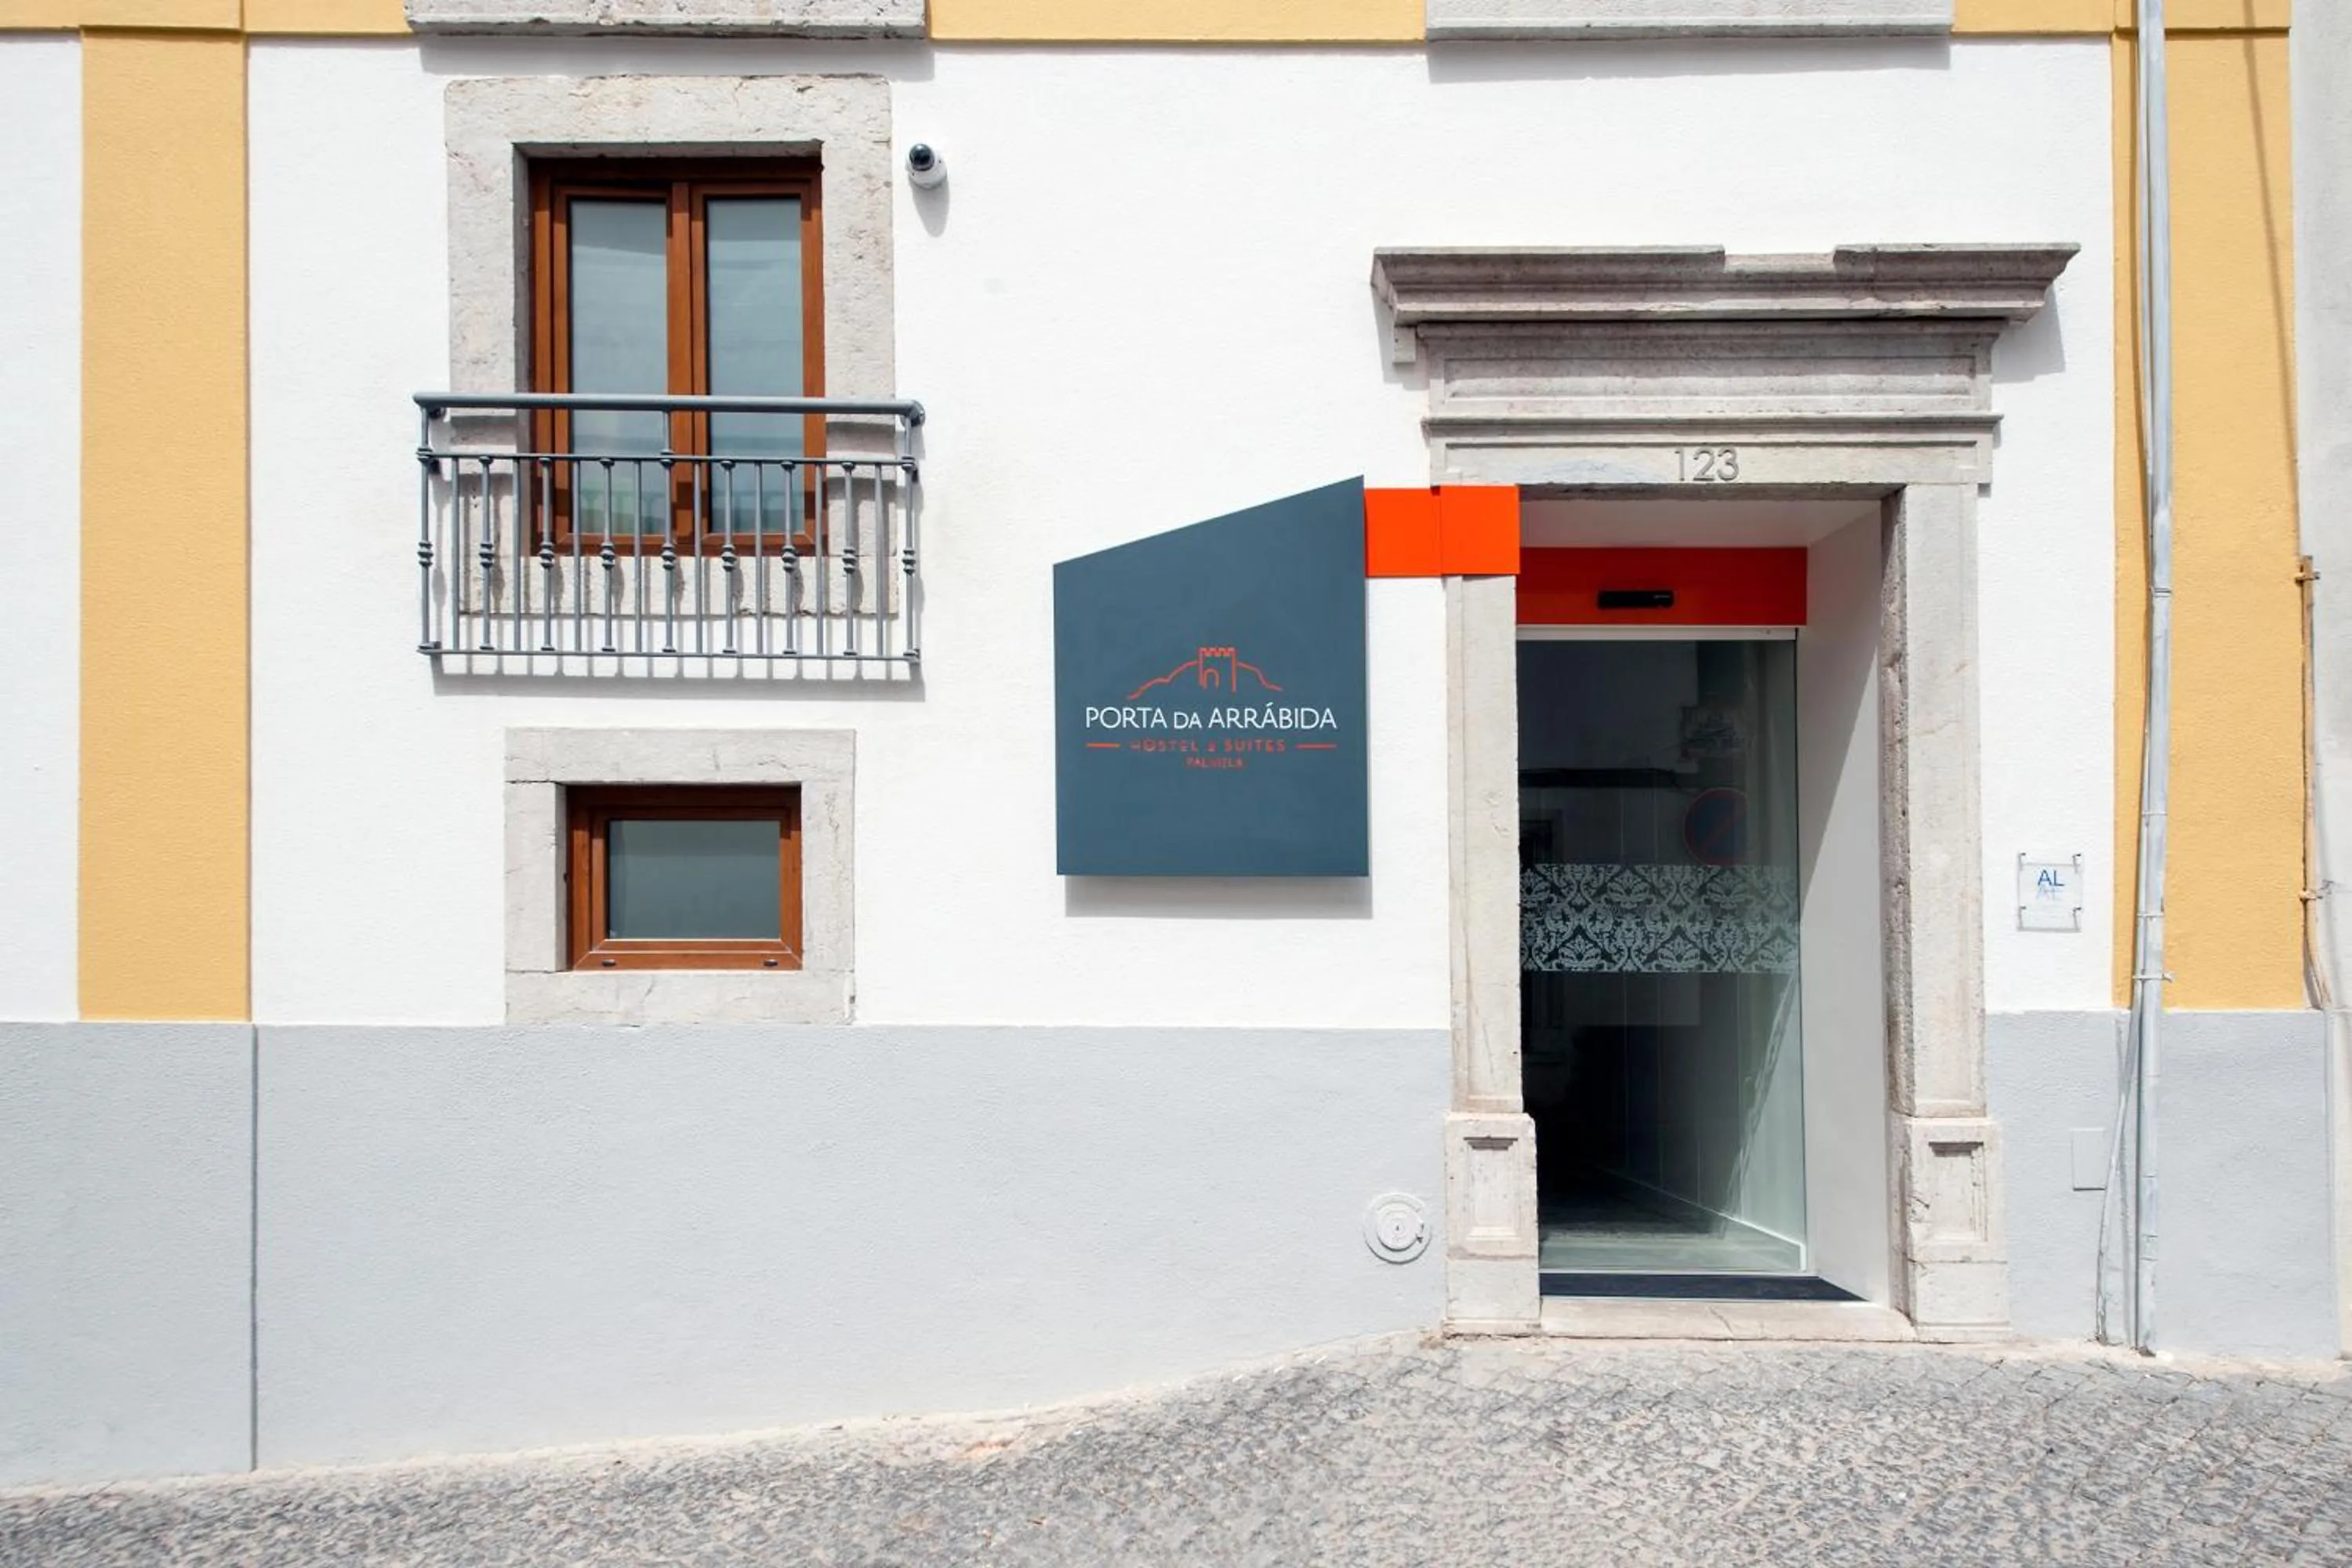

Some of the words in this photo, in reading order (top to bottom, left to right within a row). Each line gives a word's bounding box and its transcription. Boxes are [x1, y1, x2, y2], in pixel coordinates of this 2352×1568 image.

[1675, 445, 1740, 481] 123
[1085, 706, 1167, 728] PORTA
[1174, 711, 1202, 730] DA
[1208, 702, 1338, 729] ARRÁBIDA
[1130, 739, 1199, 752] HOSTEL
[1224, 739, 1286, 752] SUITES
[2038, 869, 2065, 886] AL
